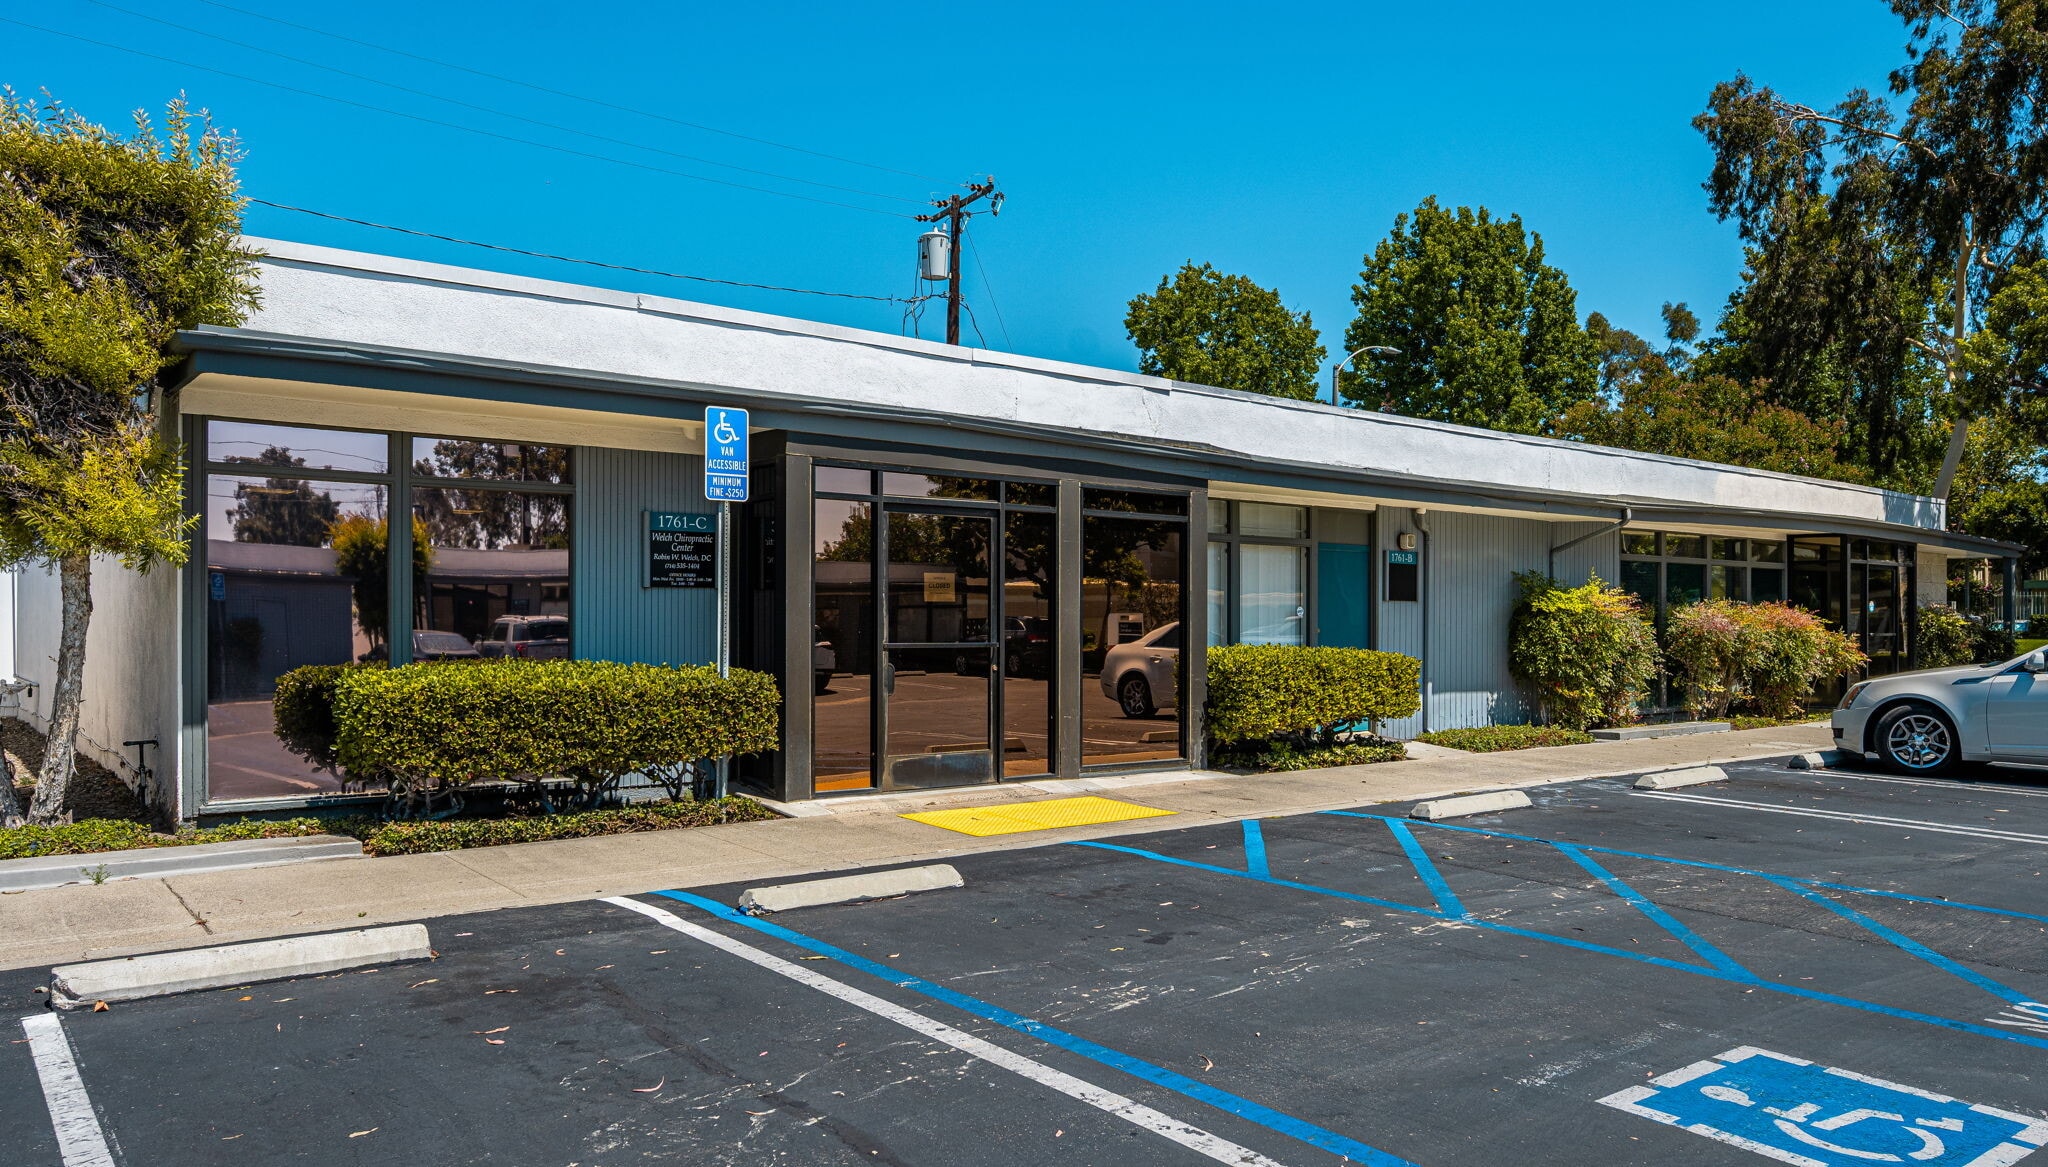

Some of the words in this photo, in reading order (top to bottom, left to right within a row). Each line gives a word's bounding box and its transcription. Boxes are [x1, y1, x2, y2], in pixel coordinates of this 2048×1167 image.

[720, 447, 734, 457] VAN
[708, 459, 746, 471] ACCESSIBLE
[712, 477, 742, 487] MINIMUM
[709, 487, 724, 497] FINE
[659, 515, 707, 530] 1761-C
[652, 532, 673, 542] Welch
[674, 533, 714, 544] Chiropractic
[671, 542, 694, 552] Center
[671, 553, 680, 561] W.
[701, 554, 712, 562] DC
[1391, 553, 1413, 563] 1761-B
